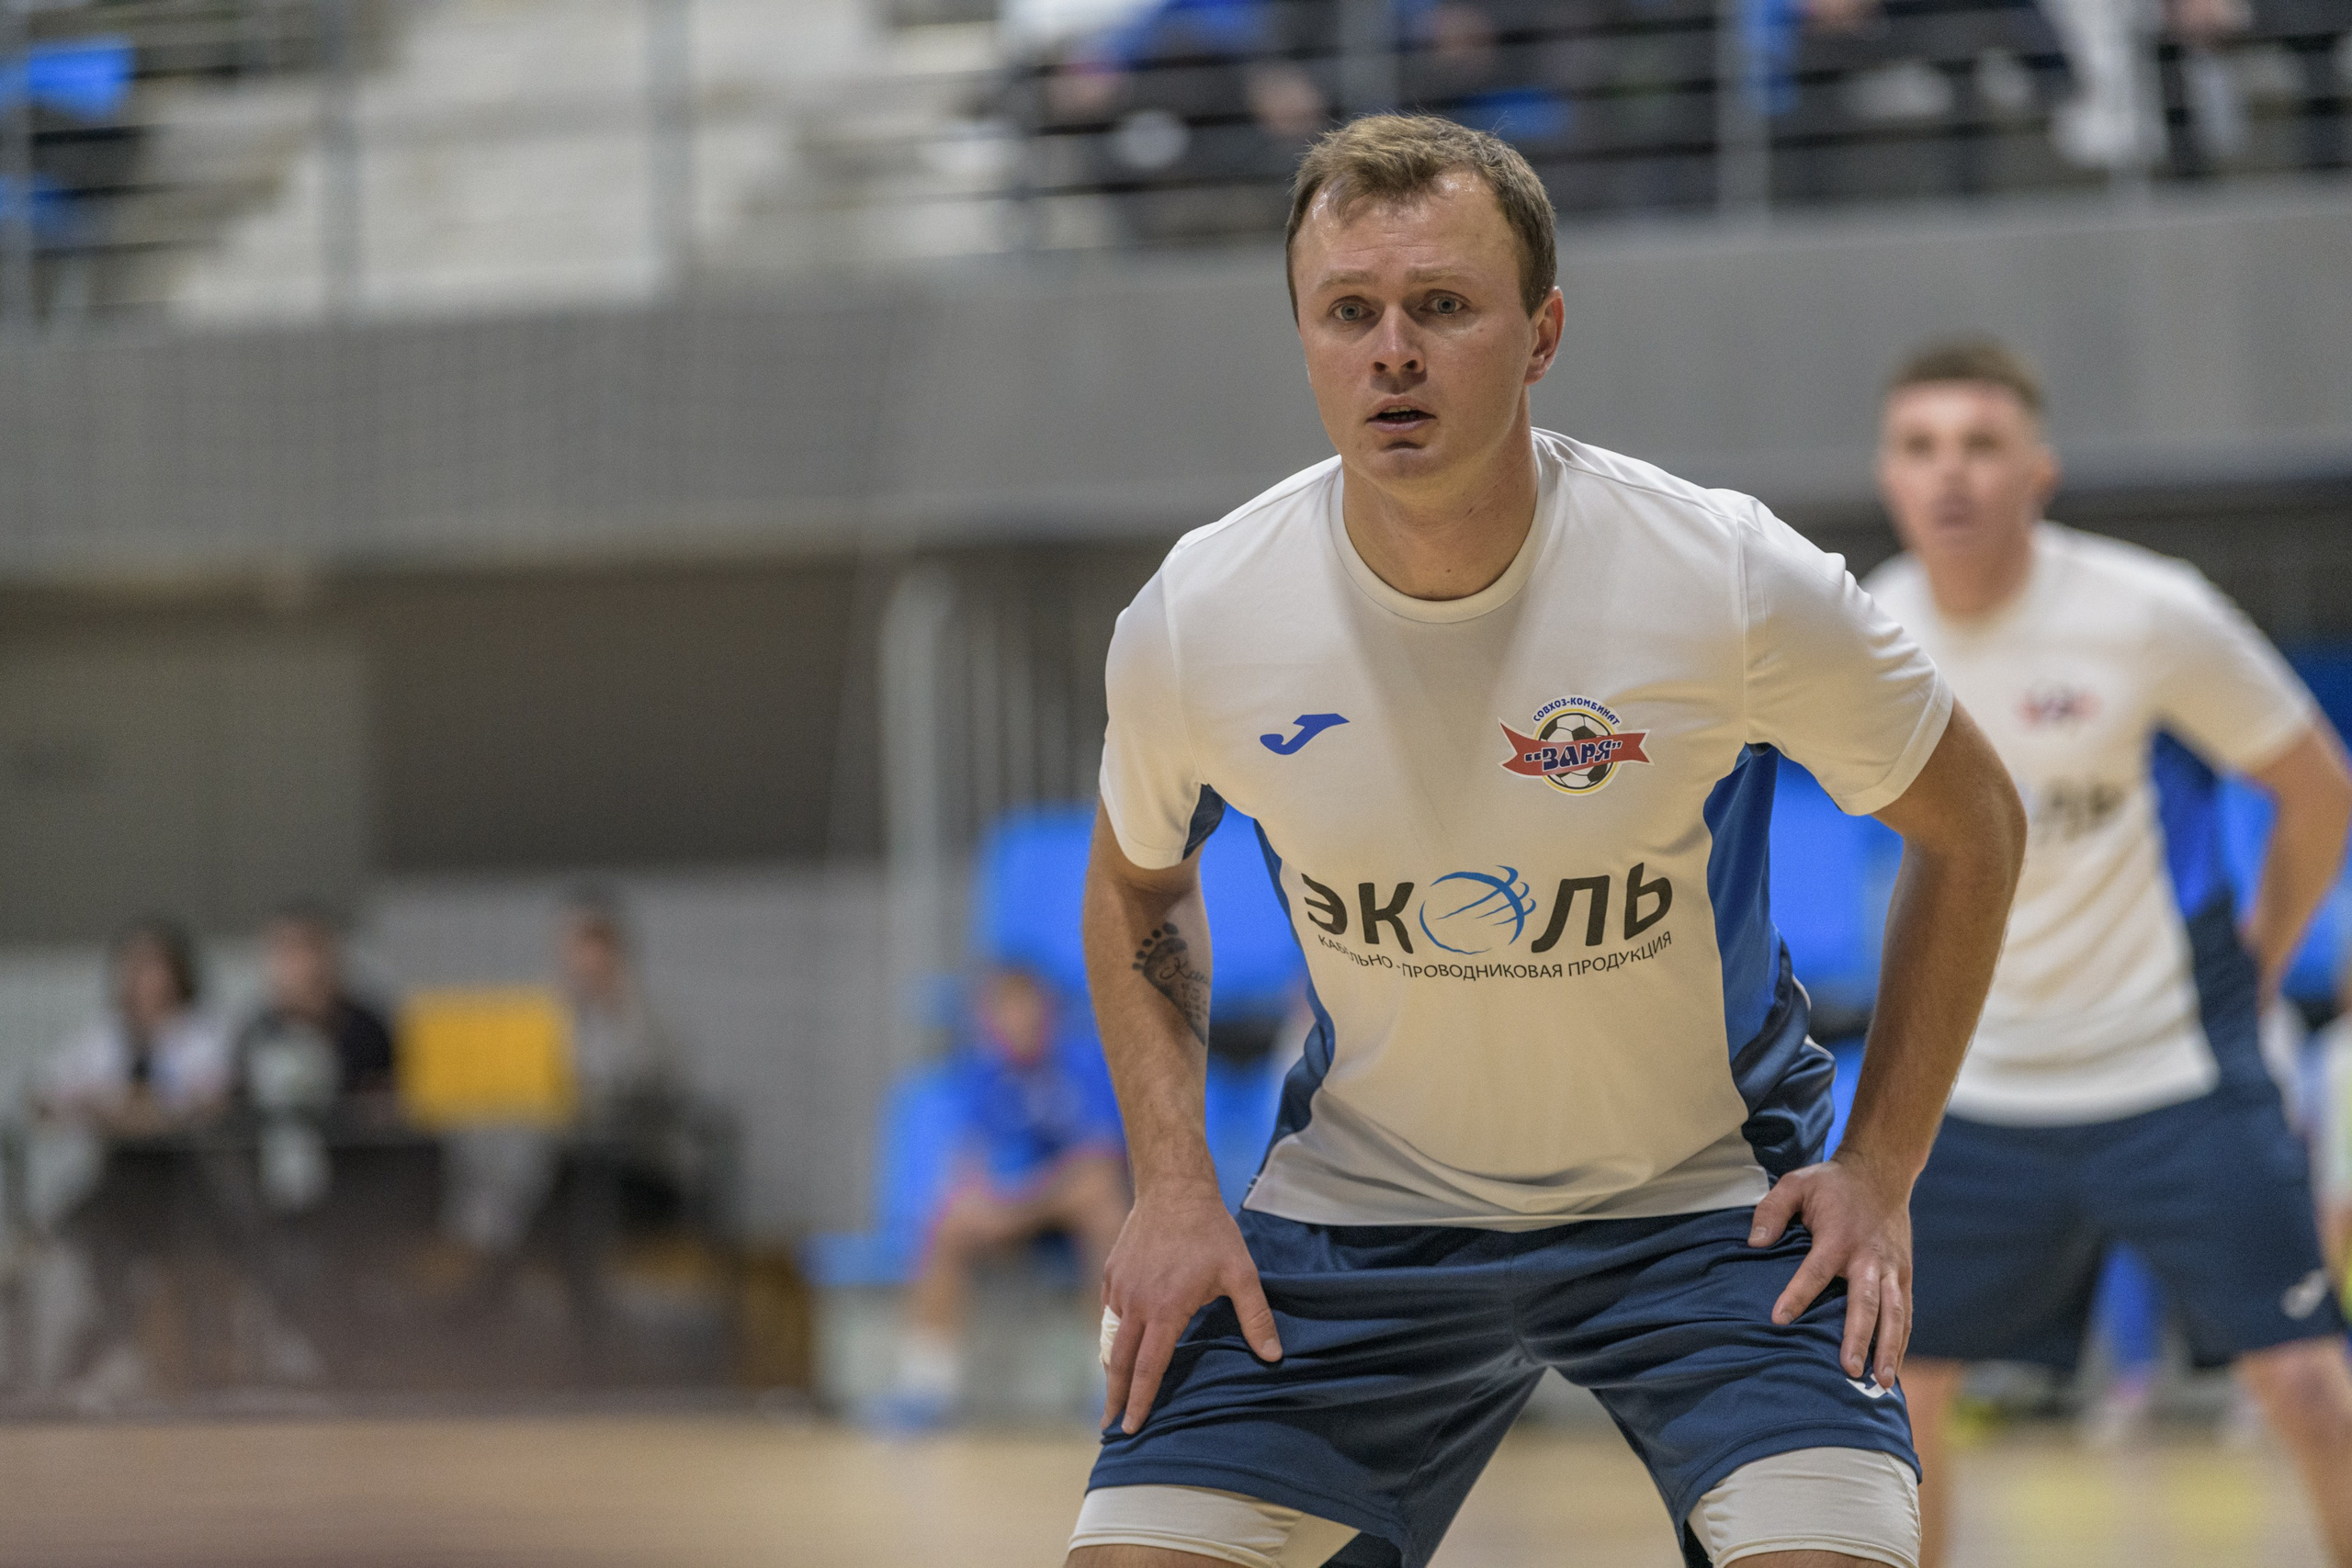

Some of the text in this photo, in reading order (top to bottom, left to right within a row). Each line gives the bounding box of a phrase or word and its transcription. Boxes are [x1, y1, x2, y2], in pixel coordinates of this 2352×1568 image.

[1532, 697, 1620, 726] СОВХОЗ-КОМБИНАТ
[1317, 931, 1672, 981] КАБЛЬНО-ПРОВОДНИКОВАЯ ПРОДУКЦИЯ
